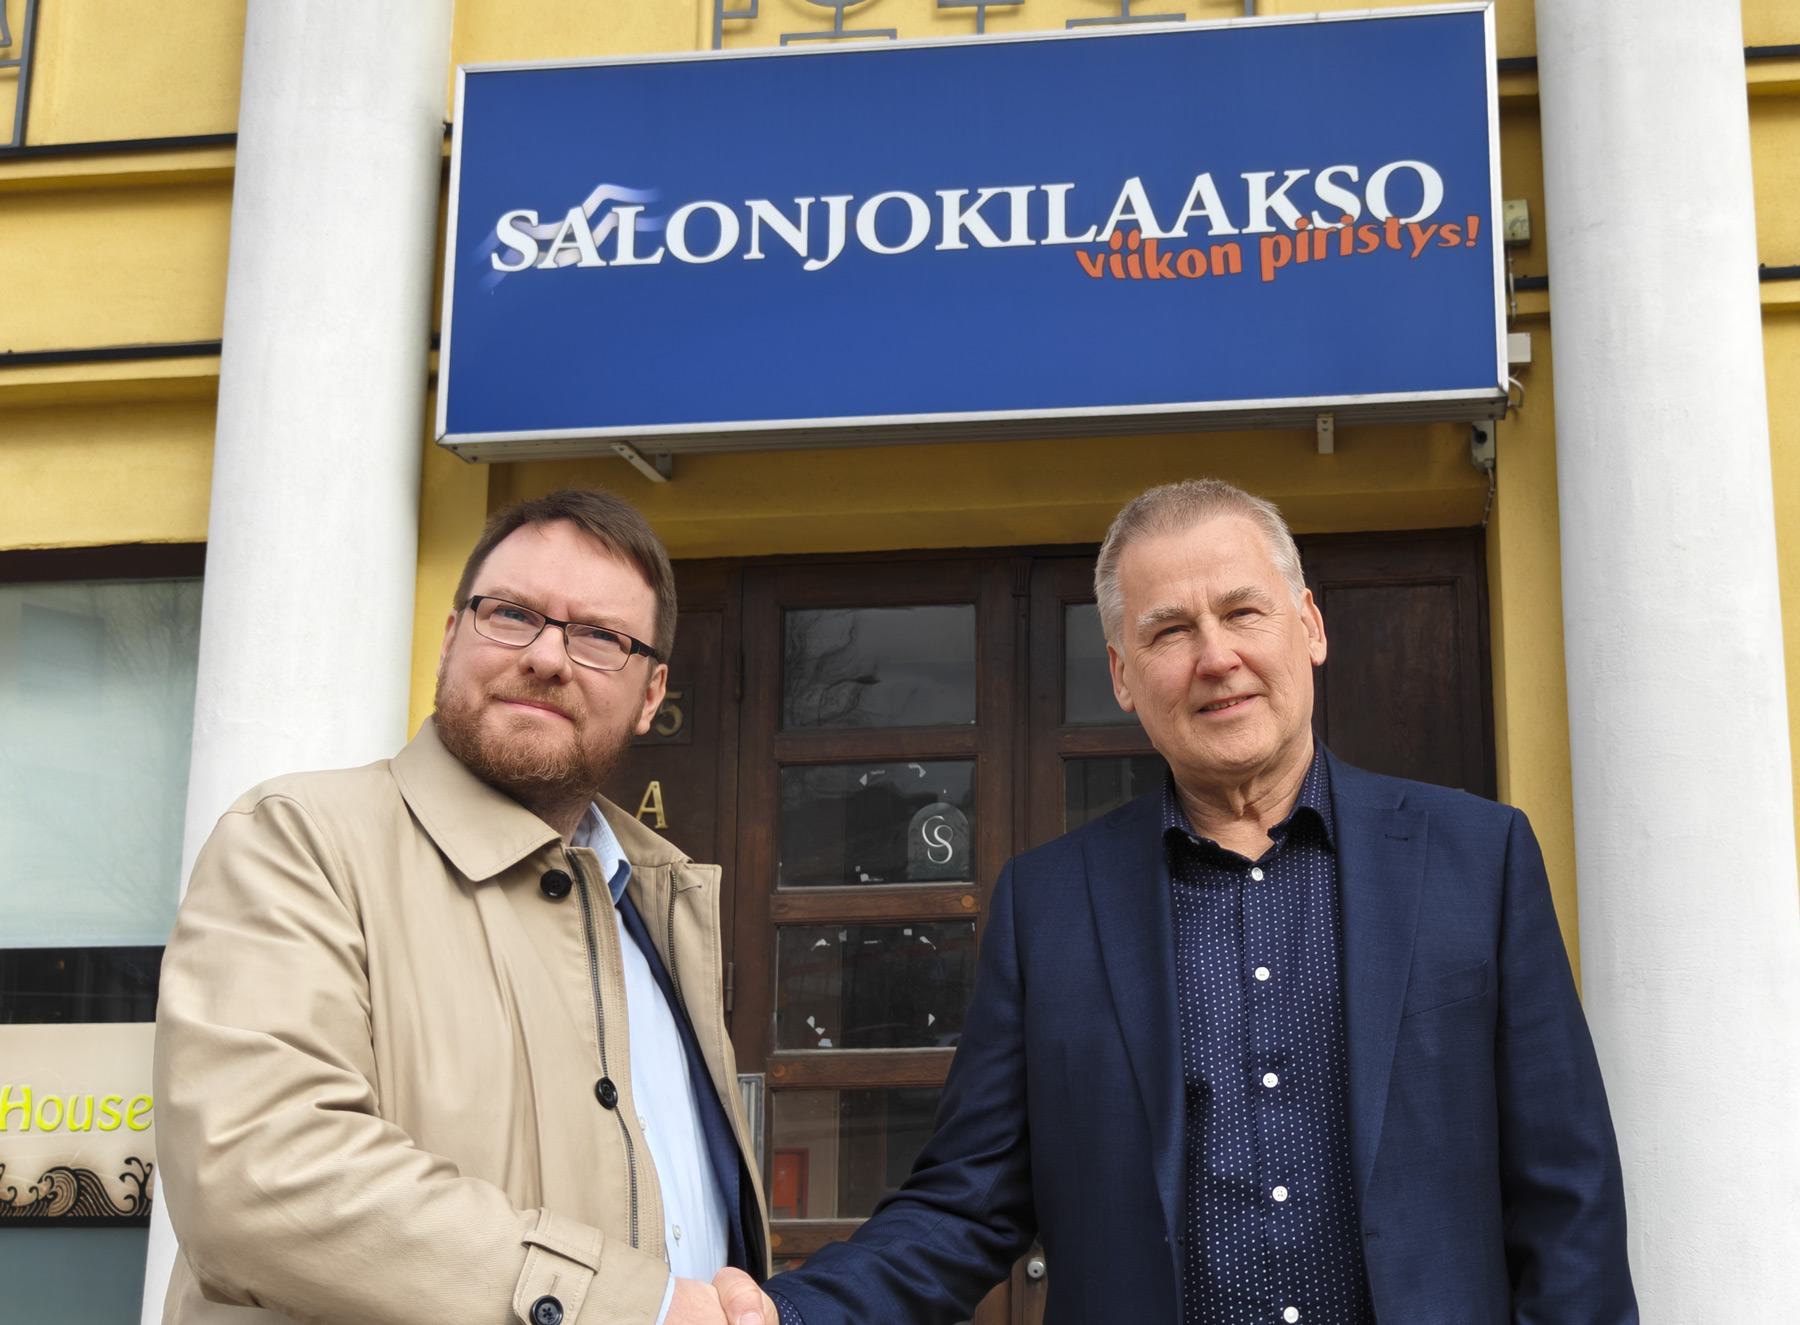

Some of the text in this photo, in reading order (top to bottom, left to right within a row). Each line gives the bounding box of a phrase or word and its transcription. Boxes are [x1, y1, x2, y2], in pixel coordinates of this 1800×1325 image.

[491, 160, 1444, 271] SALONJOKILAAKSO
[1075, 215, 1480, 282] viikon piristys!
[636, 781, 668, 829] A
[0, 1085, 153, 1131] House
